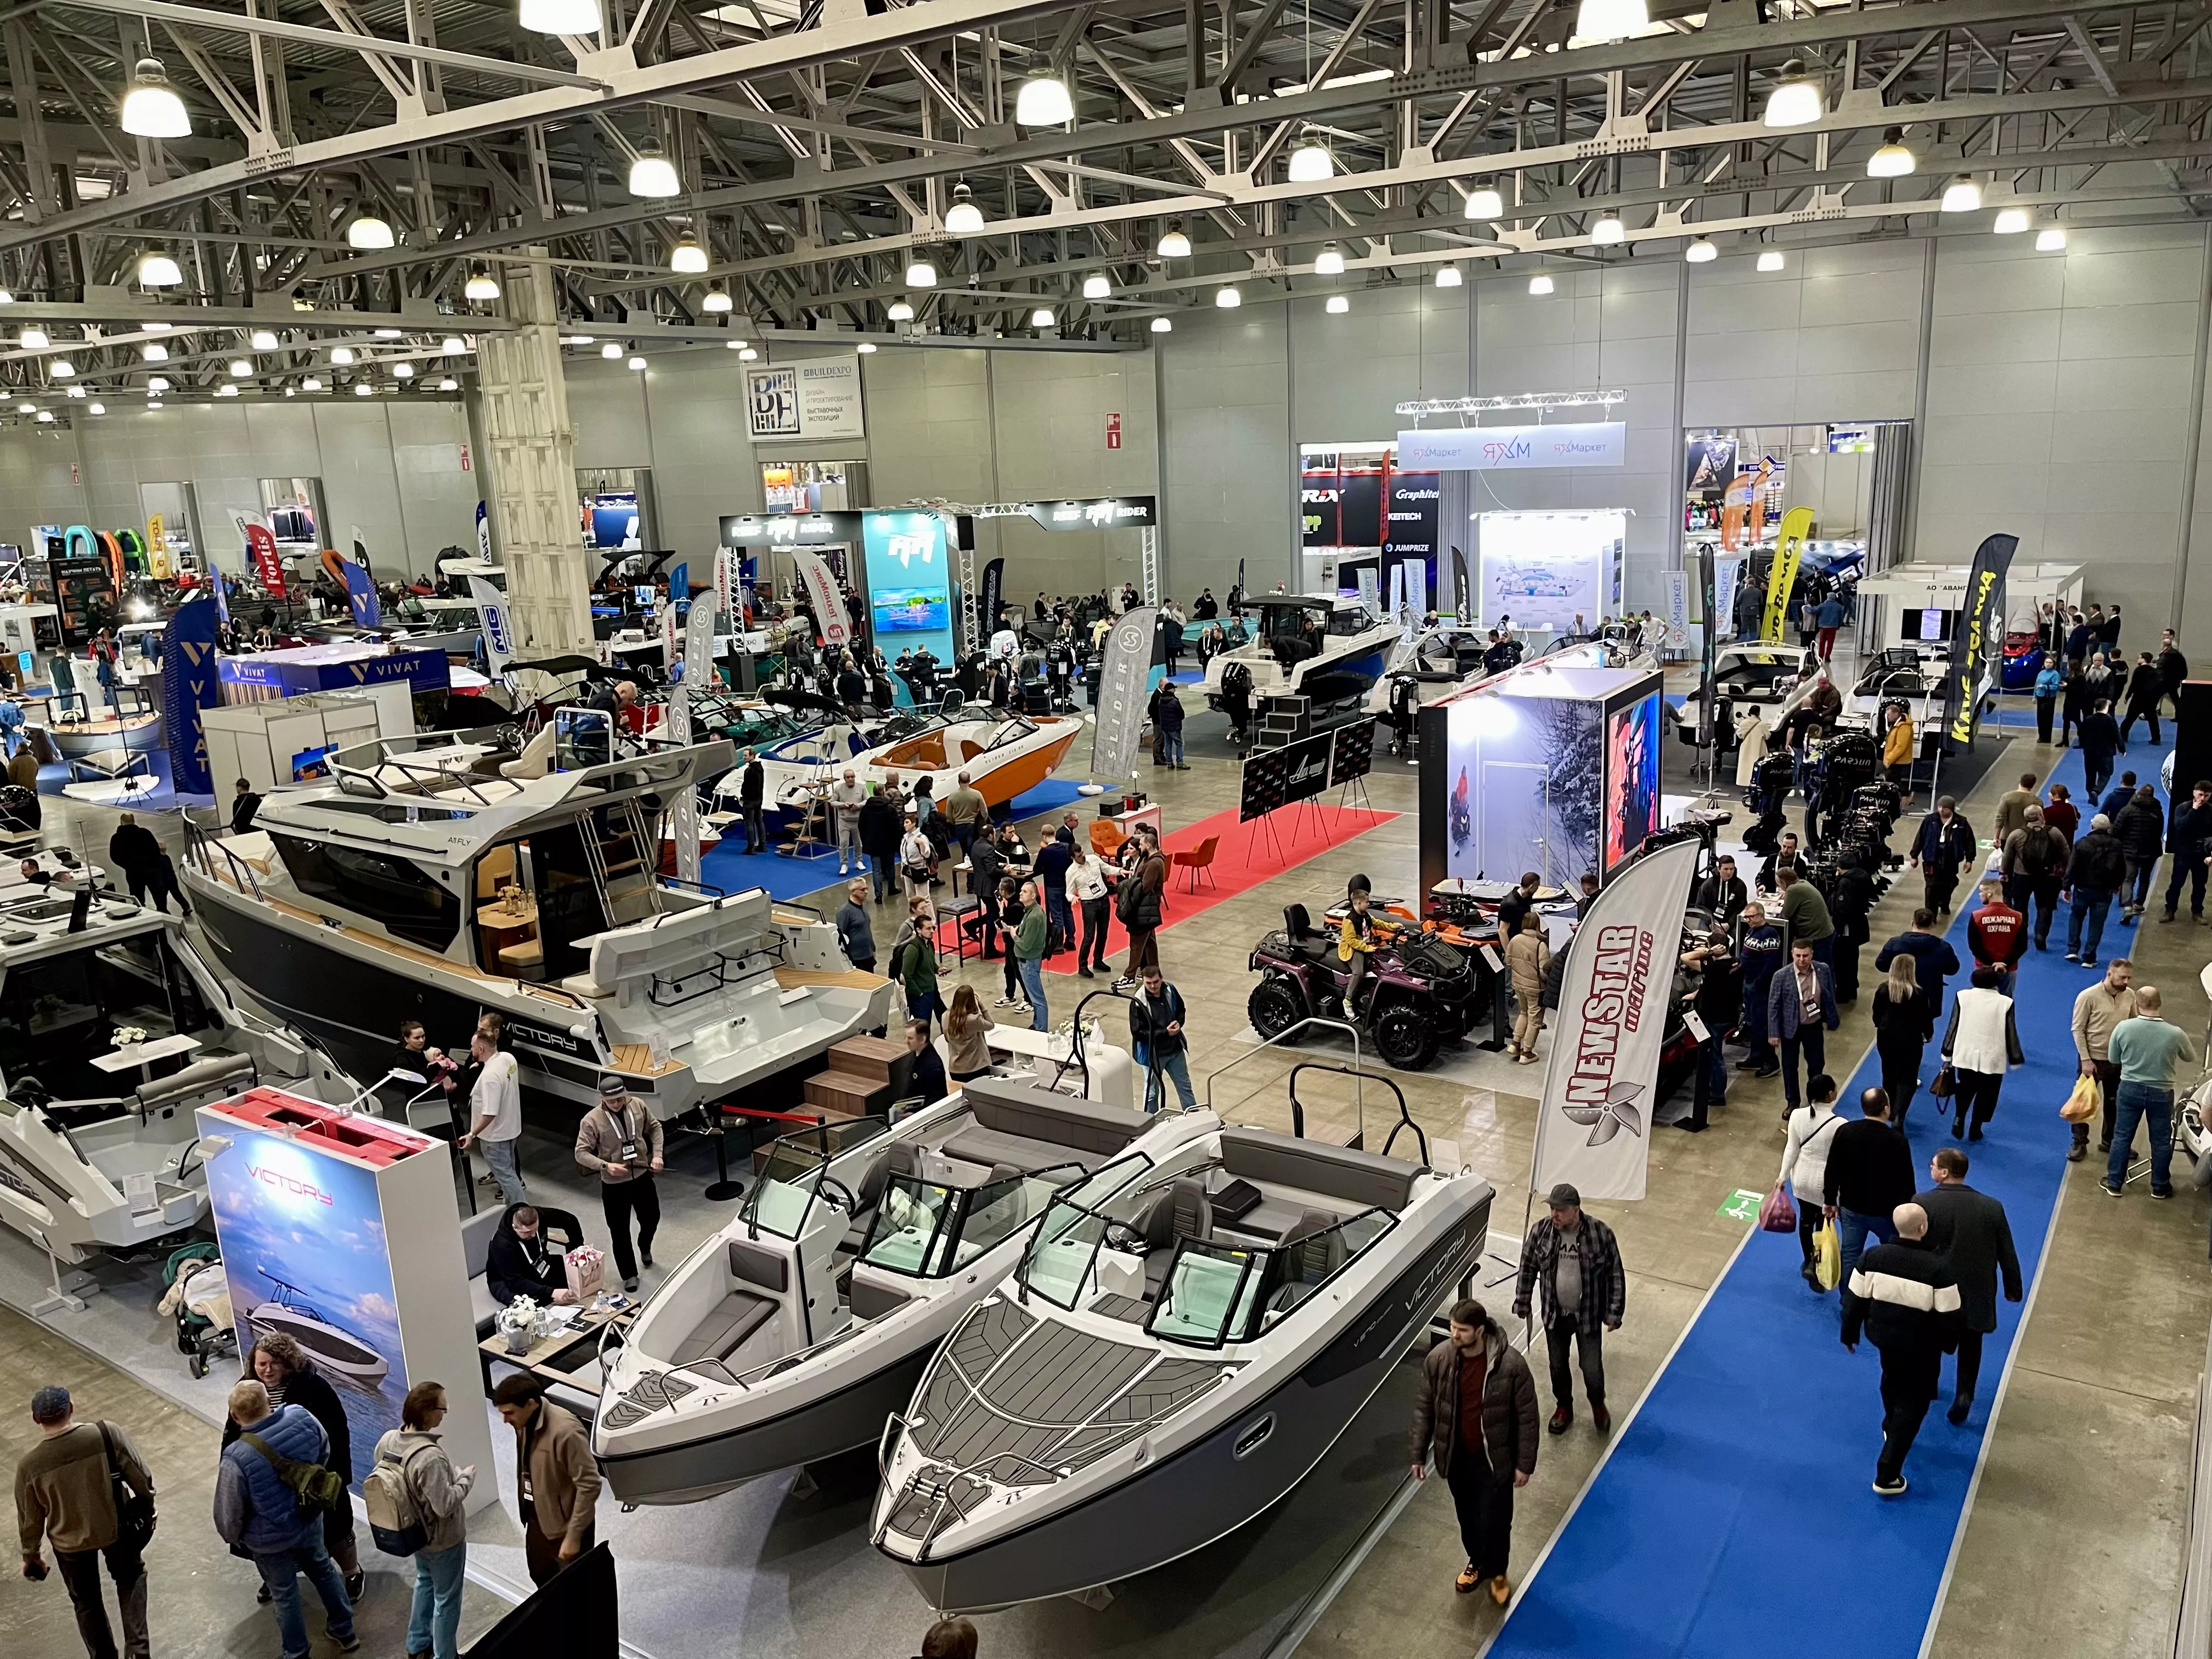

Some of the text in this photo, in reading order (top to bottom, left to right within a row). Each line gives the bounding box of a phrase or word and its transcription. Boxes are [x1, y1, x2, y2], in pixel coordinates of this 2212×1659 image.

[810, 366, 851, 376] BUILDEXPO
[808, 414, 839, 422] ЭКСПОЗИЦИЙ
[1116, 506, 1148, 517] RIDER
[1388, 512, 1421, 521] KEITECH
[257, 534, 281, 585] Fortis
[986, 569, 996, 634] XSTREAM
[486, 607, 505, 652] MG
[244, 668, 265, 677] VIVAT
[376, 660, 421, 676] VIVAT
[1108, 662, 1128, 760] SLIDER
[1834, 755, 1871, 768] PARSUN
[1860, 795, 1890, 806] PARSUN
[1982, 916, 2016, 924] ПОЖАРНАЯ
[1624, 930, 1654, 1033] marine
[1565, 925, 1637, 1103] NEWSTAR
[244, 1161, 333, 1206] VICTORY
[1405, 1229, 1466, 1311] VICTORY
